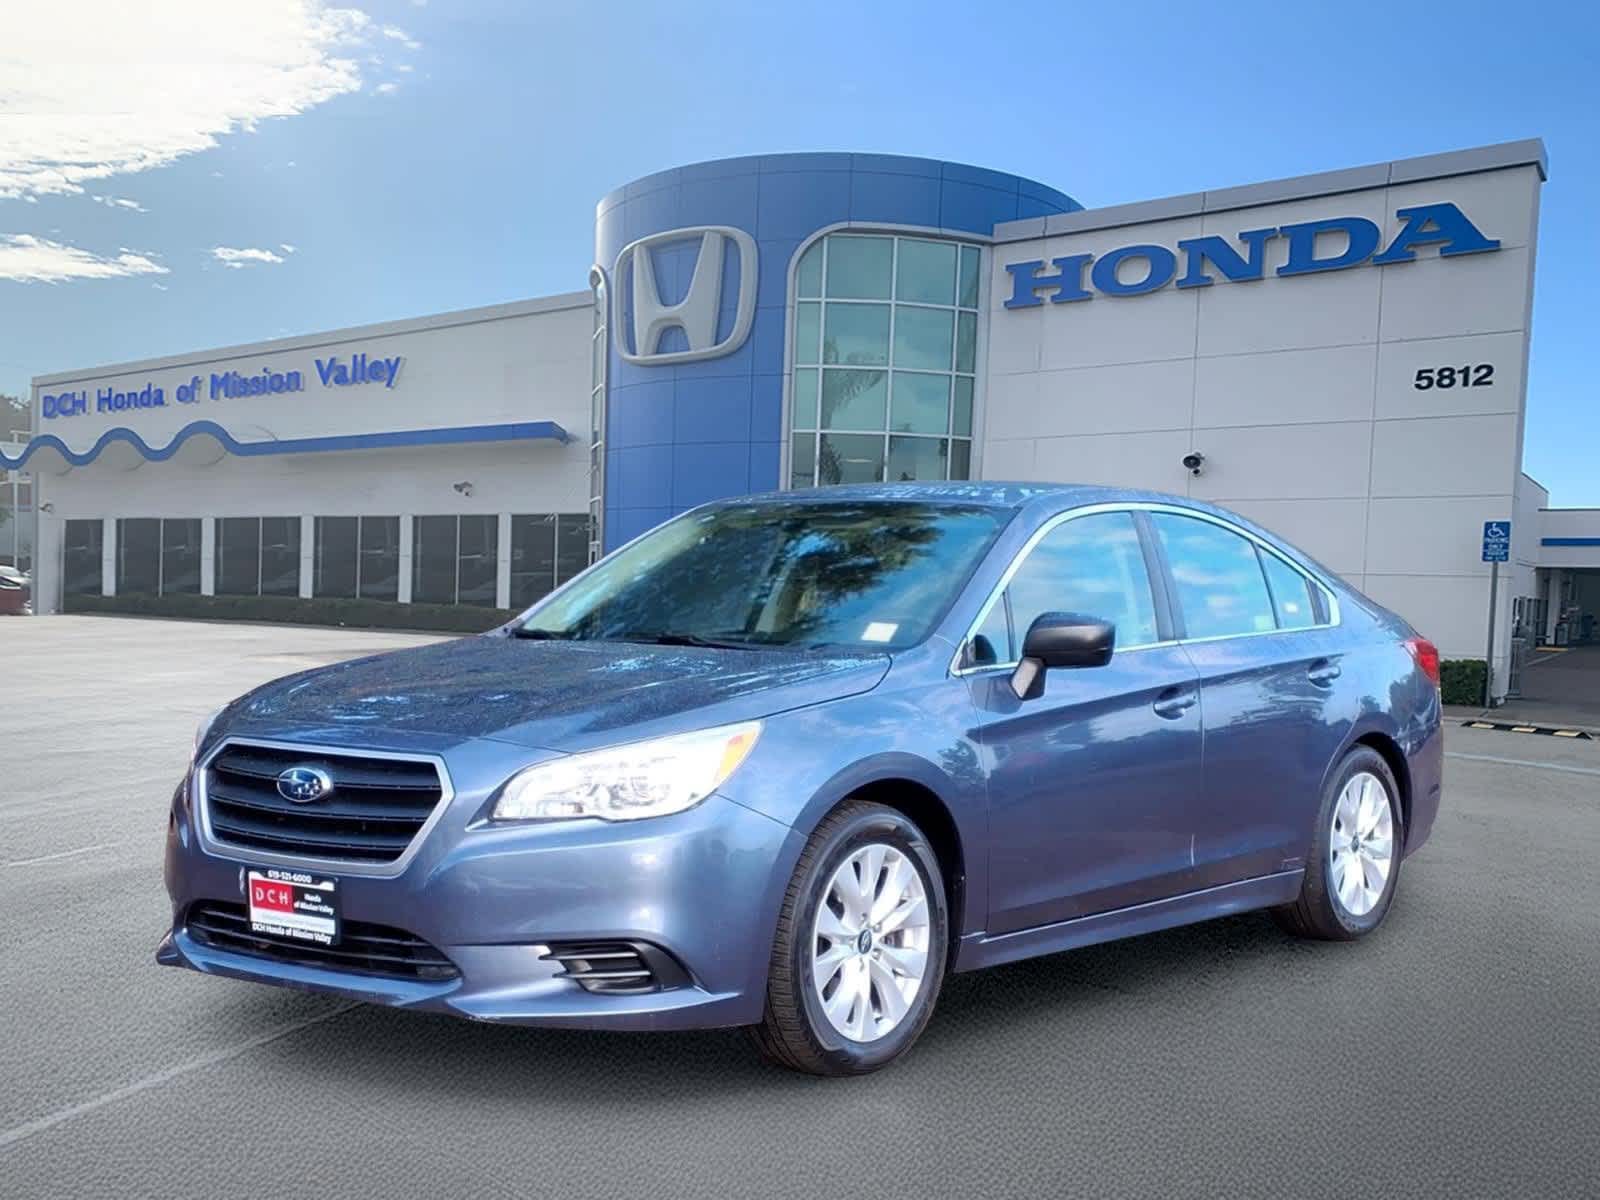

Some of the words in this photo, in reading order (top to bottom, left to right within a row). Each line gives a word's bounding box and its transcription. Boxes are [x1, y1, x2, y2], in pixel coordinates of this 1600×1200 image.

[1003, 202, 1501, 310] HONDA
[42, 390, 88, 419] DCH
[96, 382, 166, 413] Honda
[176, 376, 203, 403] of
[209, 367, 304, 400] Mission
[313, 353, 403, 388] Valley
[1413, 364, 1495, 391] 5812
